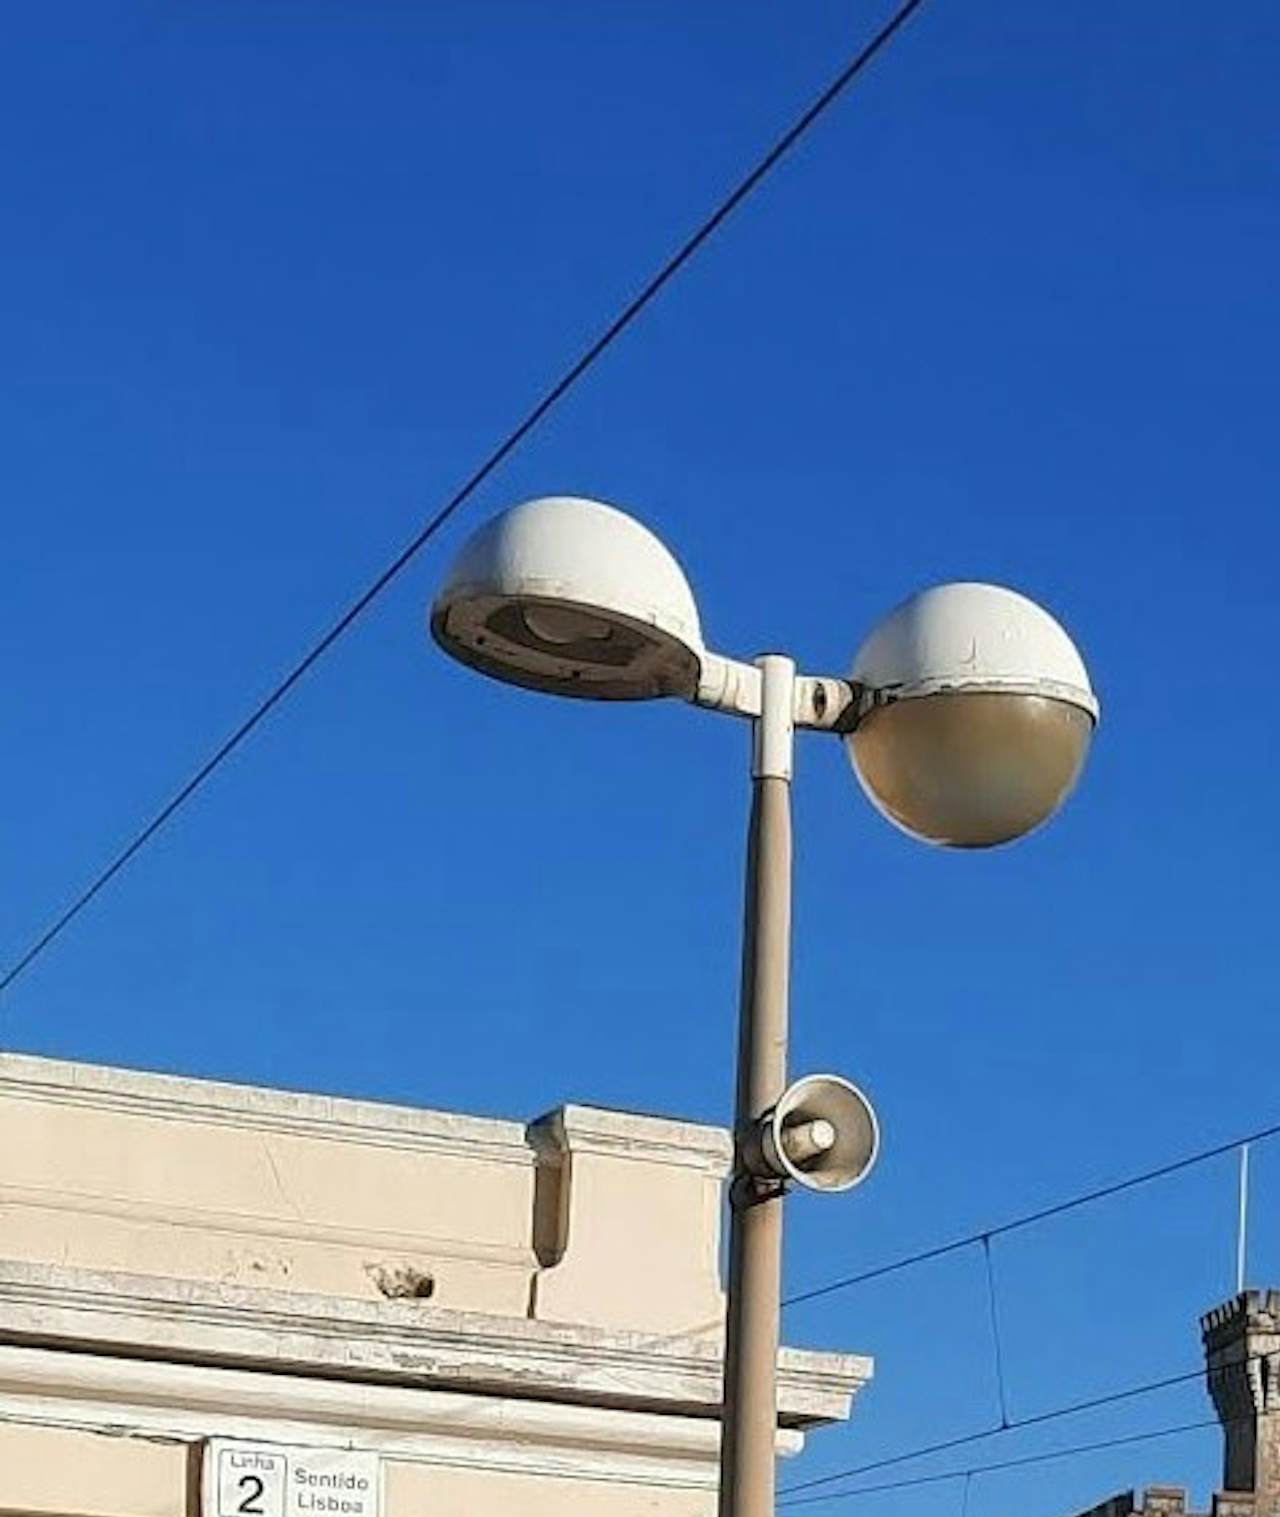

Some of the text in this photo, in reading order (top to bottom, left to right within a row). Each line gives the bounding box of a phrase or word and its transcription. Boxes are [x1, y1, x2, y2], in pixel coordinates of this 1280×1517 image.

[295, 1467, 369, 1490] Sentido
[238, 1475, 264, 1514] 2
[298, 1493, 364, 1514] Lisboa
